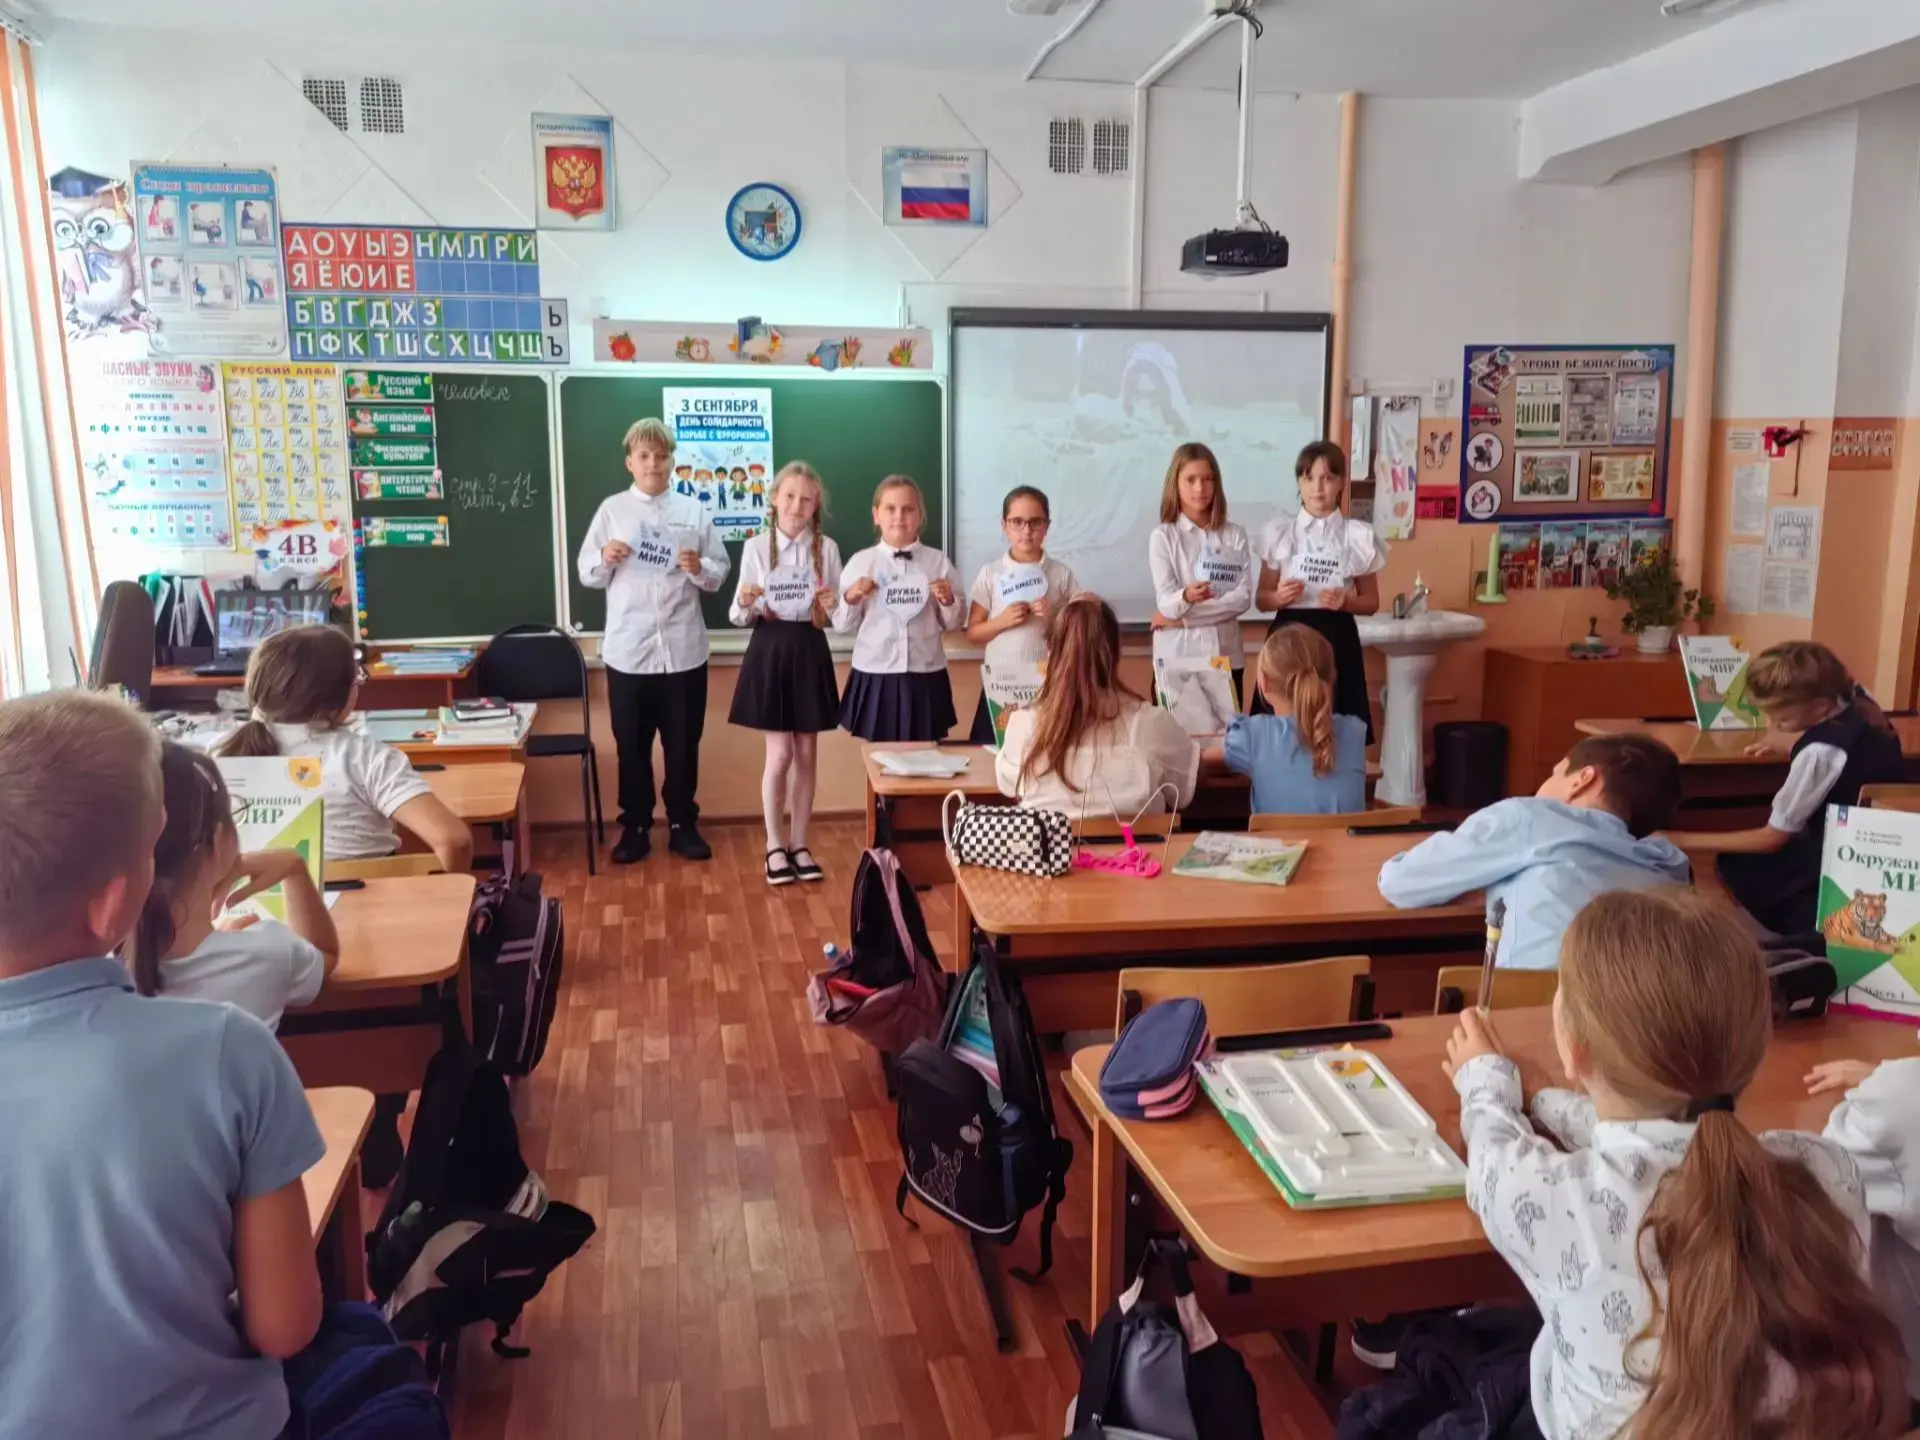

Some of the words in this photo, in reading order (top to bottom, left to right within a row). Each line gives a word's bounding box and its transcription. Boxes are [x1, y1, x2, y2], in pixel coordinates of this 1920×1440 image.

[1522, 359, 1560, 369] УРОКИ
[1565, 358, 1656, 369] БЕЗОПАСНОСТИ
[154, 362, 194, 377] ЗВУКИ
[378, 375, 421, 386] Русский
[681, 399, 690, 412] 3
[694, 399, 758, 413] СЕНТЯБРЯ
[373, 411, 431, 422] Английский
[680, 416, 701, 428] ДЕНЬ
[703, 416, 762, 428] СОЛИДАРНОСТИ
[680, 429, 707, 440] БОРЬБЕ
[278, 534, 318, 556] 4В
[640, 541, 658, 552] МЫ
[659, 545, 671, 556] ЗА
[638, 551, 669, 567] МИР!
[1304, 557, 1338, 567] СКАЖЕМ
[1300, 564, 1333, 576] ТЕРРОРУ
[1210, 572, 1237, 582] ВАЖНА!
[1308, 575, 1329, 584] НЕТ!
[769, 583, 809, 591] ВЫБИРАЕМ
[1015, 577, 1044, 591] ВМЕСТЕ!
[774, 592, 806, 601] ДОБРО!
[887, 588, 921, 596] ДРУЖБА
[1709, 664, 1735, 673] МИР
